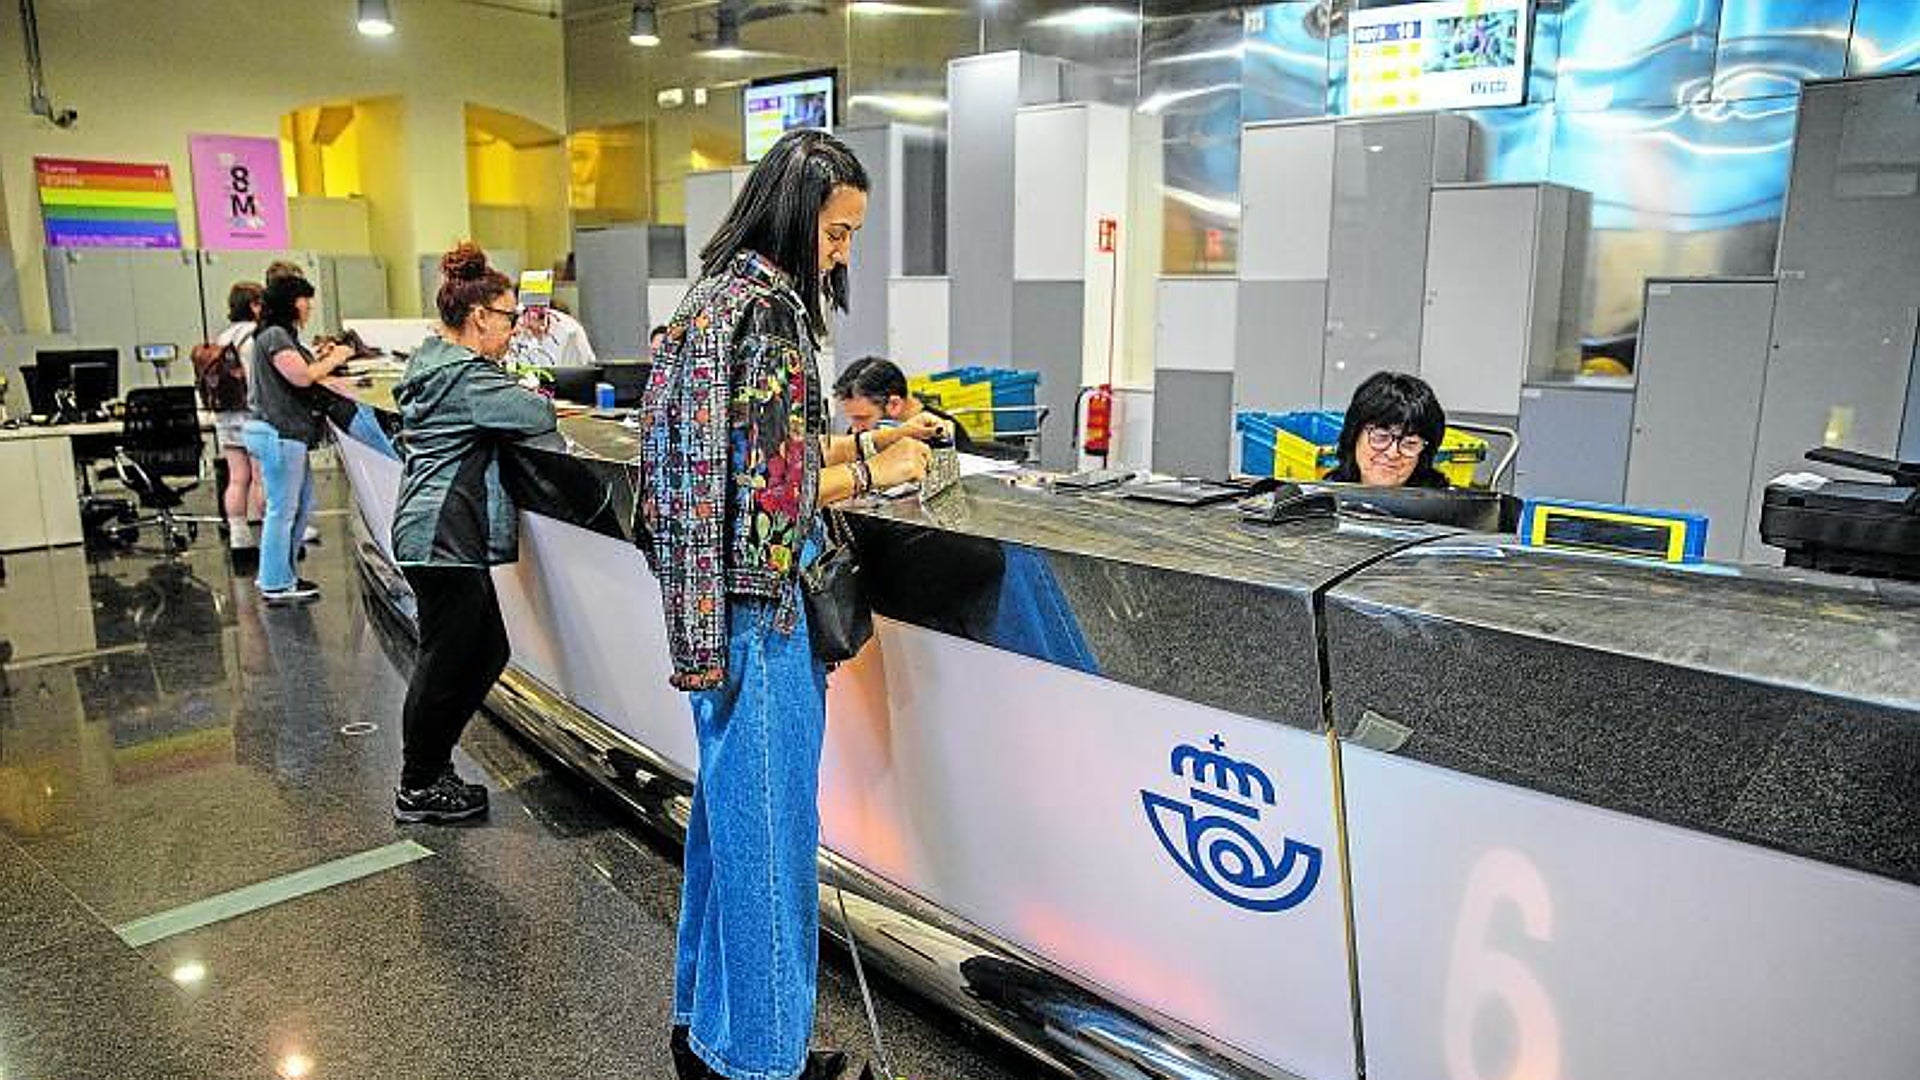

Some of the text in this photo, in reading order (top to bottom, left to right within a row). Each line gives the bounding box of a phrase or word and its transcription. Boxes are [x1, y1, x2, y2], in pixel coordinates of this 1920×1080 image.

[230, 166, 250, 193] 8
[231, 194, 256, 217] M
[1443, 845, 1562, 1080] 6
